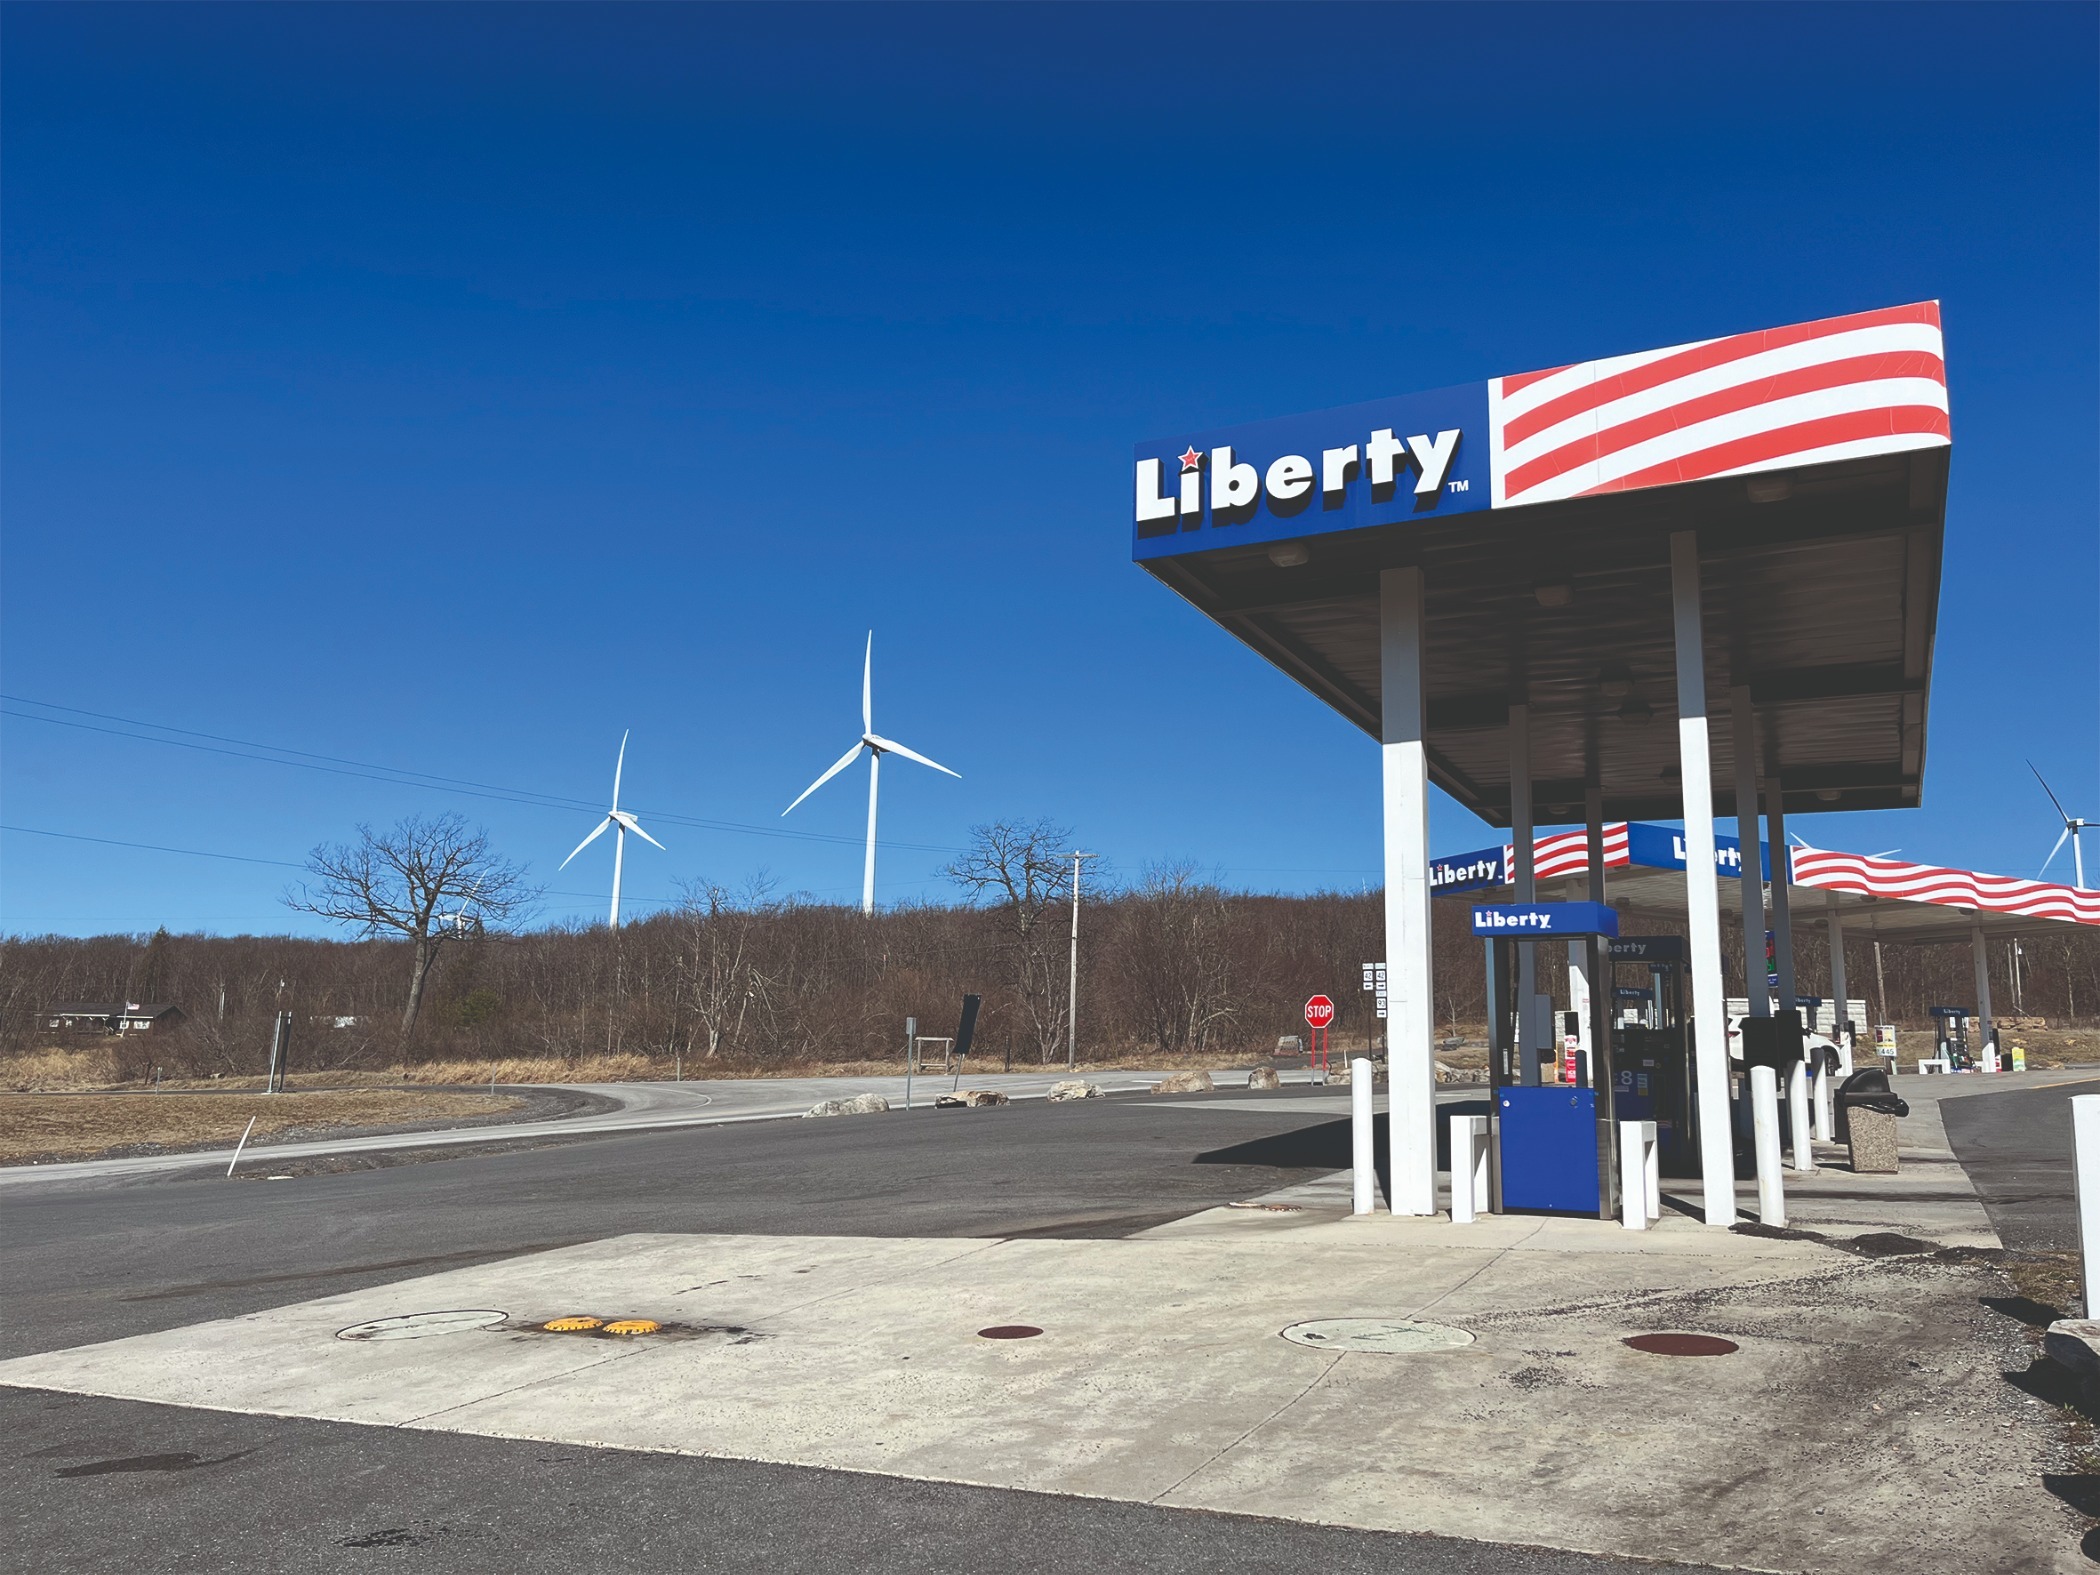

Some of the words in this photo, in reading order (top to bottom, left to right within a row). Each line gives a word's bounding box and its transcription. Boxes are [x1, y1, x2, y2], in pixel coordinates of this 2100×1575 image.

[1136, 428, 1461, 522] Liberty
[1448, 480, 1469, 494] TM
[1429, 860, 1497, 886] Liberty
[1475, 910, 1551, 929] Liberty
[1307, 1005, 1332, 1018] STOP
[1621, 1070, 1633, 1085] 8
